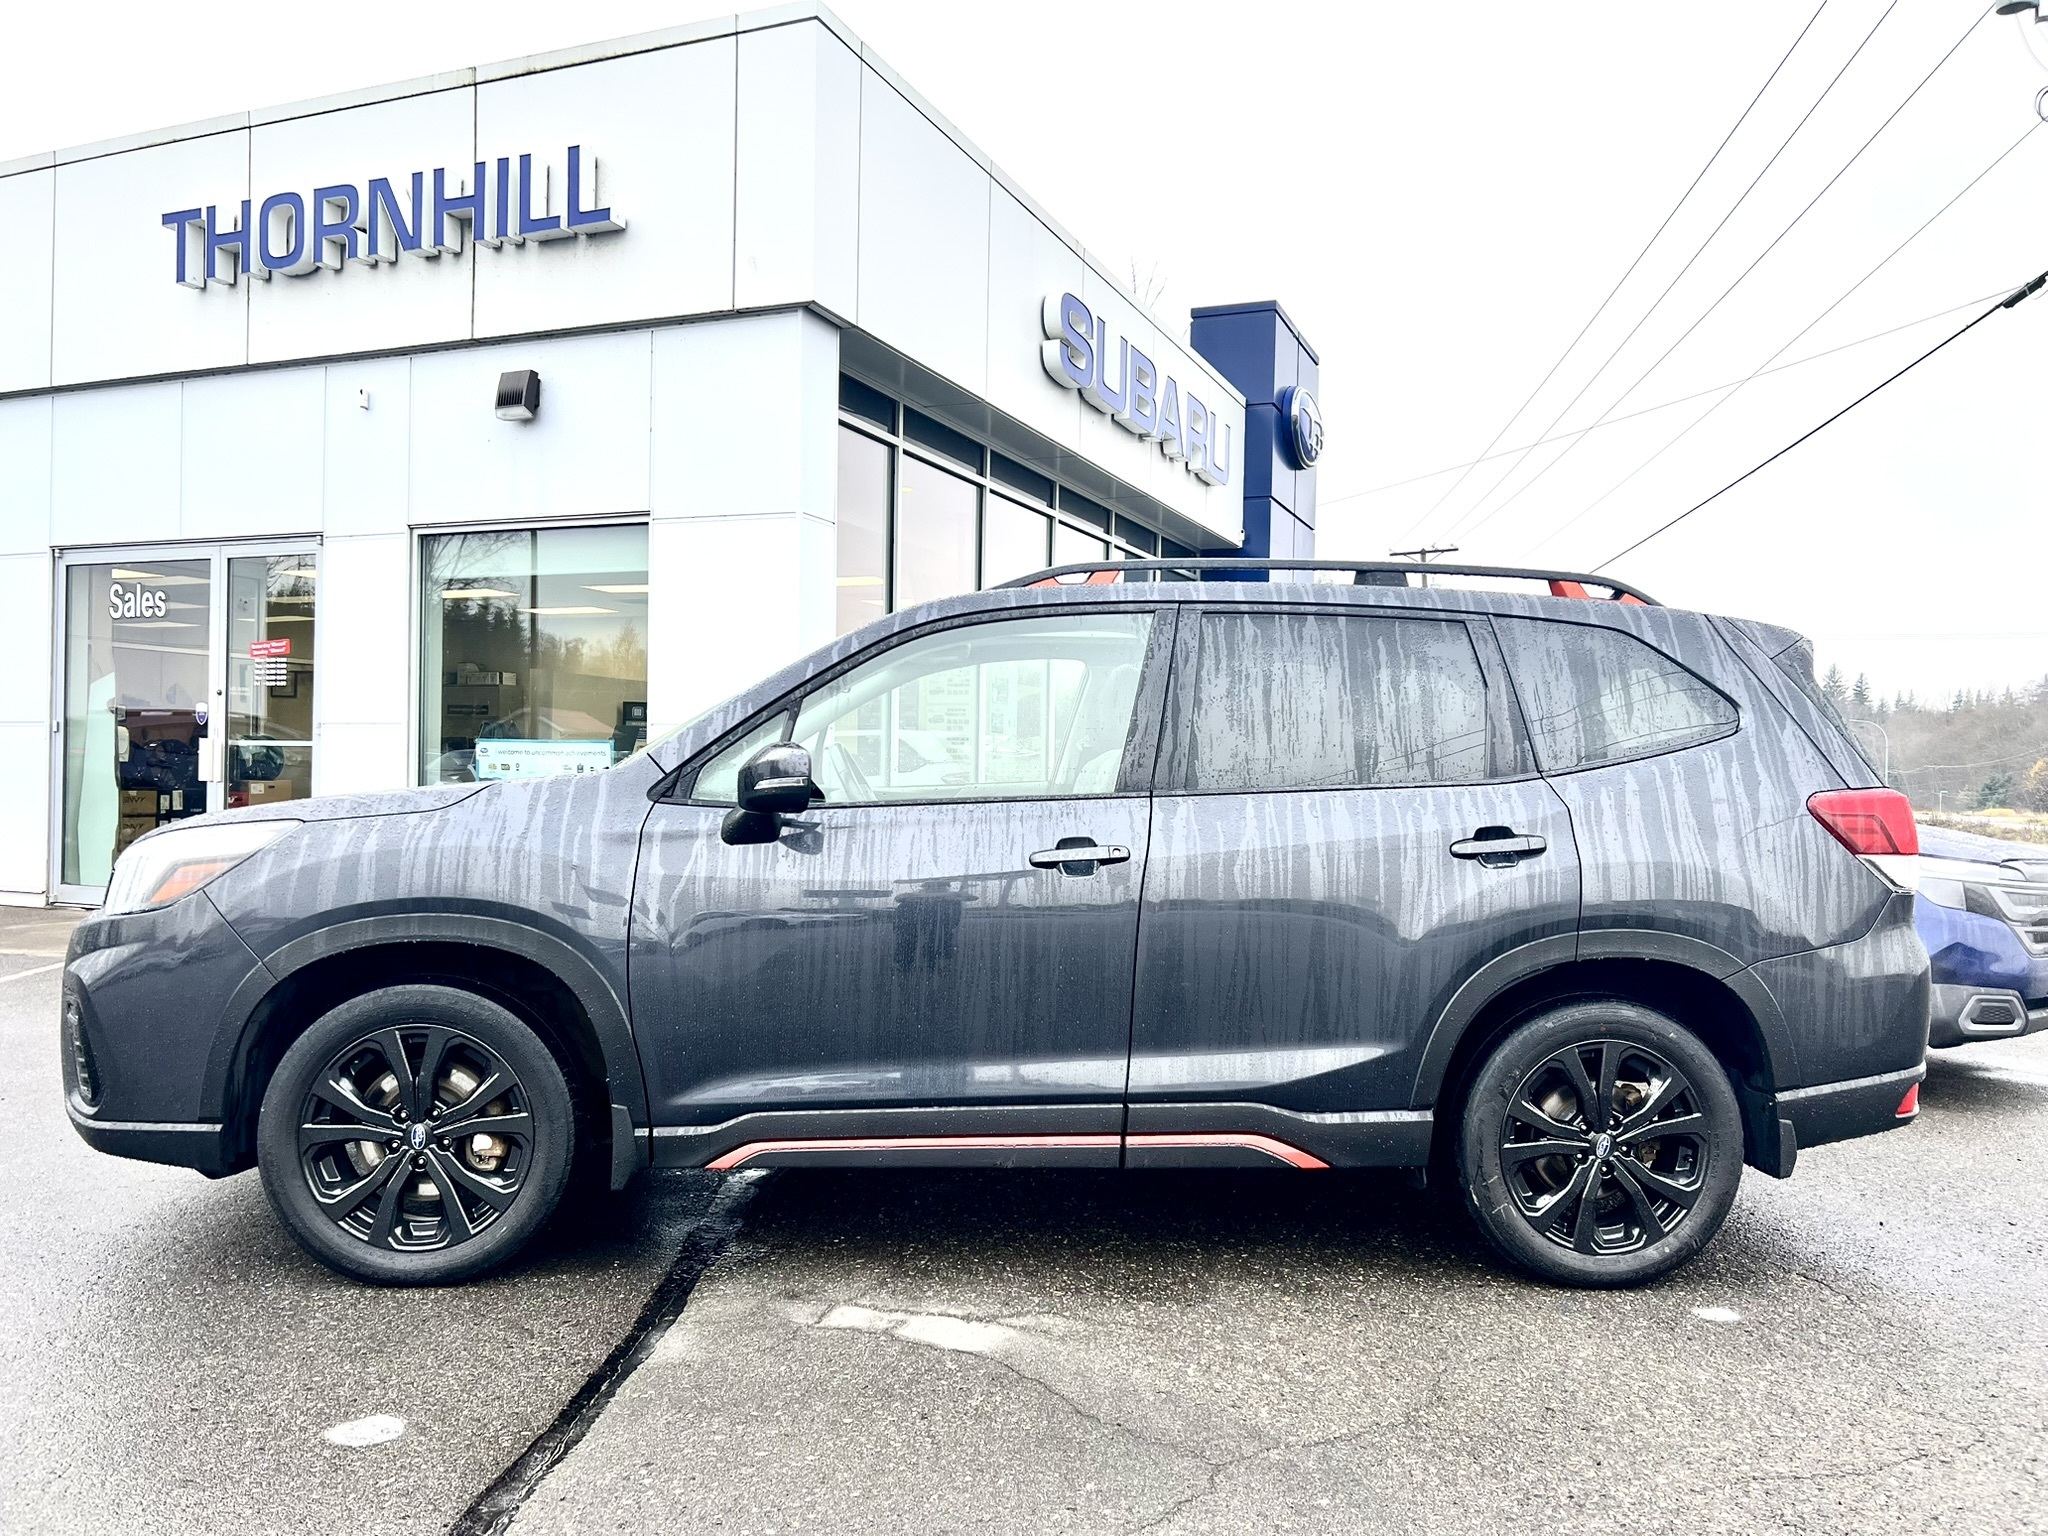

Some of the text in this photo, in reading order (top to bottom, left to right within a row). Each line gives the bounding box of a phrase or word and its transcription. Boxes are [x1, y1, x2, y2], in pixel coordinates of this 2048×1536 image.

[161, 145, 613, 286] THORNHILL
[1050, 292, 1231, 486] SUBARU
[108, 582, 167, 620] Sales
